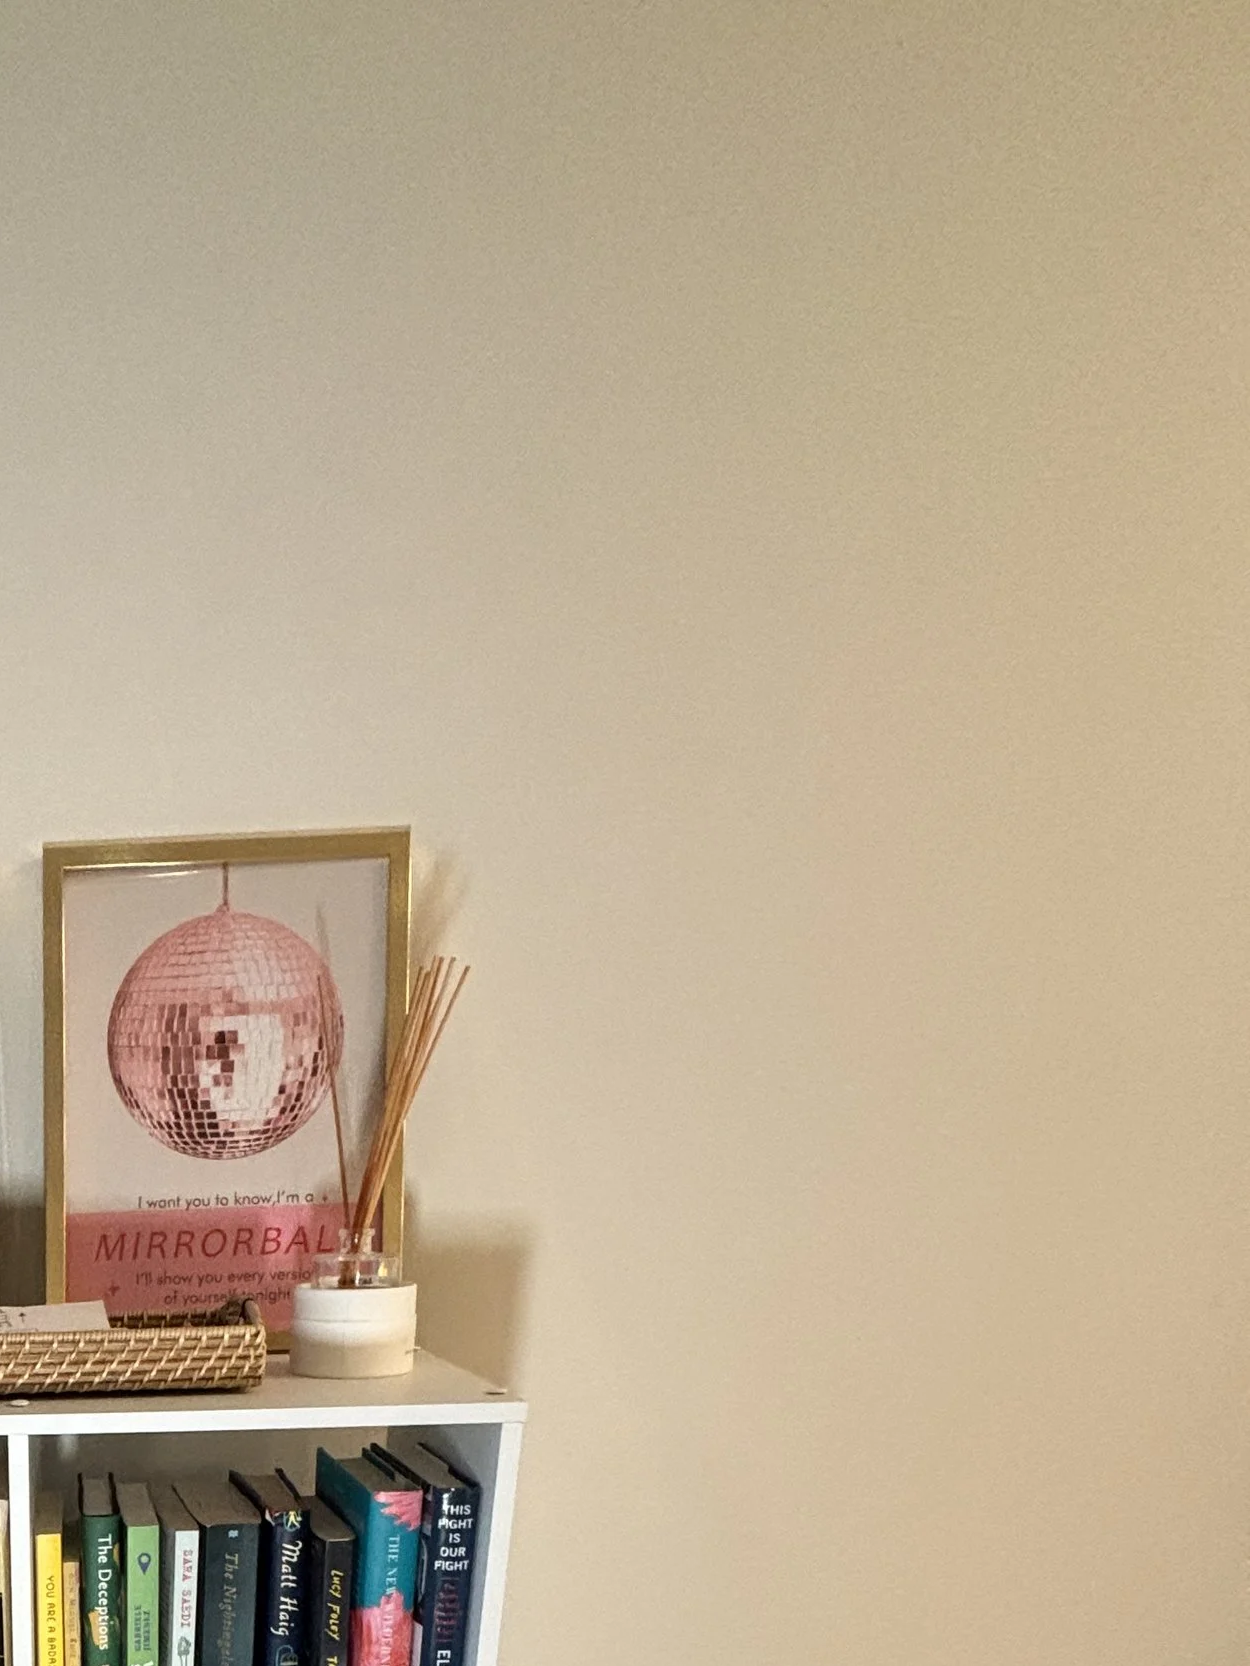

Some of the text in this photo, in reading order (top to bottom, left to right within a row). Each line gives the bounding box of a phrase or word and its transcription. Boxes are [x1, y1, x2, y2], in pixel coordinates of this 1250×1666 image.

[138, 1196, 143, 1209] I
[146, 1196, 180, 1209] want
[184, 1196, 210, 1211] you
[215, 1194, 229, 1206] to
[306, 1193, 314, 1203] a
[94, 1224, 336, 1263] MIRRORBAL
[157, 1270, 194, 1286] show
[197, 1271, 223, 1289] you
[227, 1270, 264, 1285] every
[270, 1268, 313, 1282] versio
[164, 1292, 178, 1304] of
[96, 1534, 113, 1565] The
[386, 1535, 400, 1562] THE
[449, 1532, 461, 1543] IS
[433, 1558, 470, 1572] FIGHT
[439, 1545, 467, 1559] OUR
[270, 1540, 303, 1637] Matt Haig
[329, 1568, 344, 1598] LUCY
[46, 1575, 56, 1622] YOU ARE
[96, 1568, 114, 1651] Deceptions
